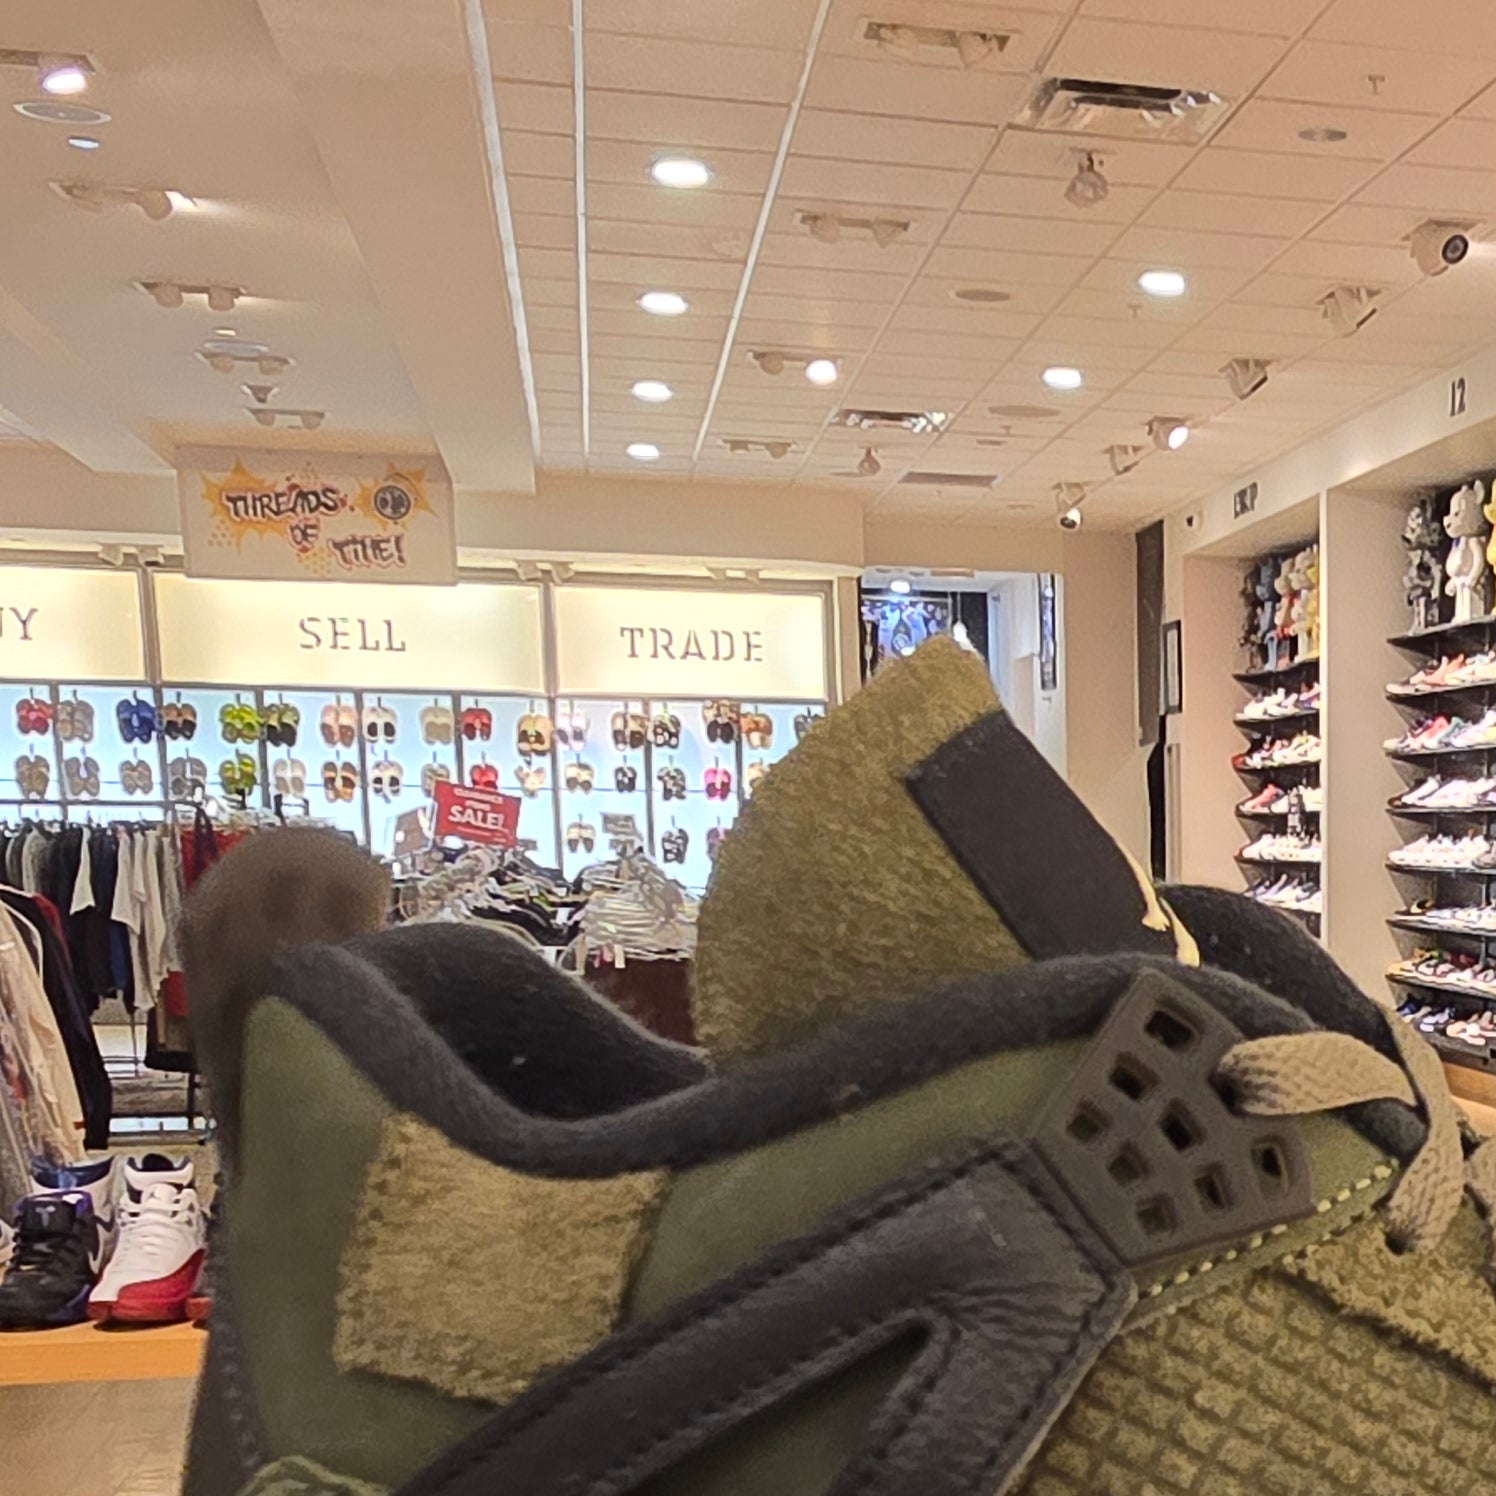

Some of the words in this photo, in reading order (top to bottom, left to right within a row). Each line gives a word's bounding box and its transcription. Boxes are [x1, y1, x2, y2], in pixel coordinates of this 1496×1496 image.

[1450, 377, 1466, 417] 12
[224, 487, 341, 518] THREADS
[290, 523, 319, 545] OF
[299, 616, 406, 652] SELL
[619, 626, 764, 662] TRADE
